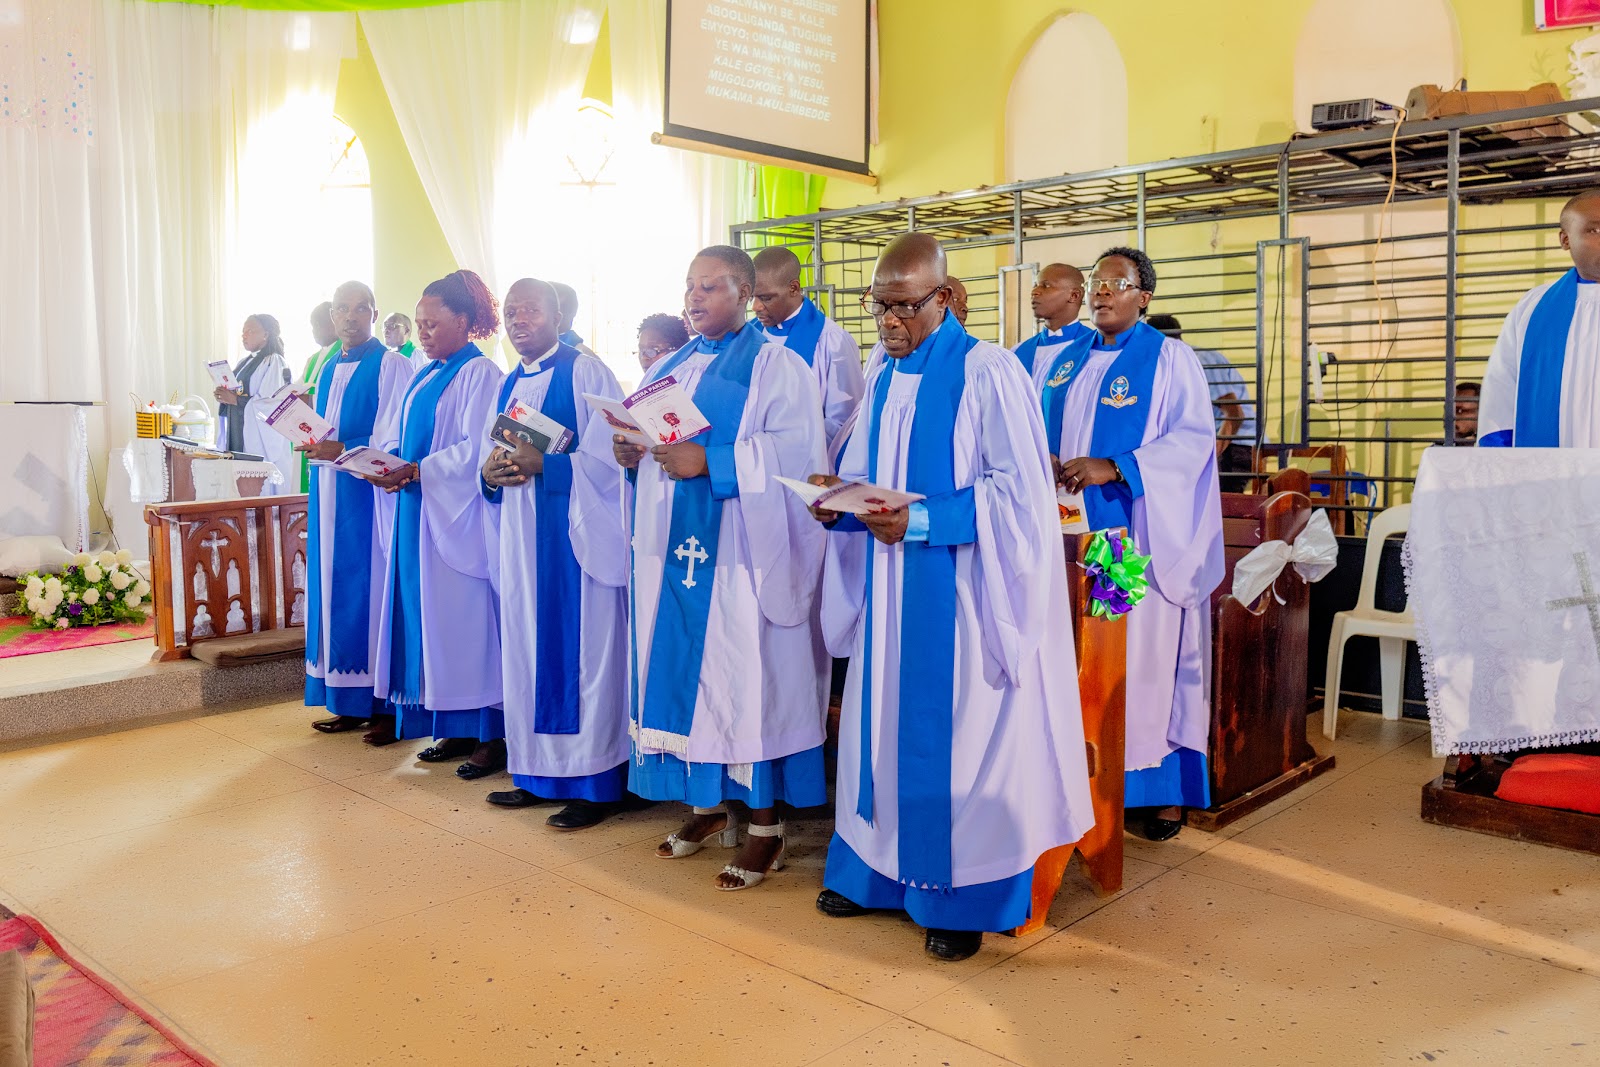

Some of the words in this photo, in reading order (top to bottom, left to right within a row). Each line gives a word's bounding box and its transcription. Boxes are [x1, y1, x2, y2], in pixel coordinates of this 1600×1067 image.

[799, 12, 825, 28] KALE
[792, 25, 833, 46] TUGUME
[714, 37, 729, 51] YE
[731, 42, 749, 56] WA
[752, 31, 801, 53] OMUGABE
[803, 44, 837, 62] WAFFE
[713, 54, 743, 71] KALE
[704, 84, 753, 105] MUKAMA
[755, 95, 831, 122] AKULEMBEDDE
[789, 86, 830, 106] MULABE
[648, 379, 670, 393] PARISH
